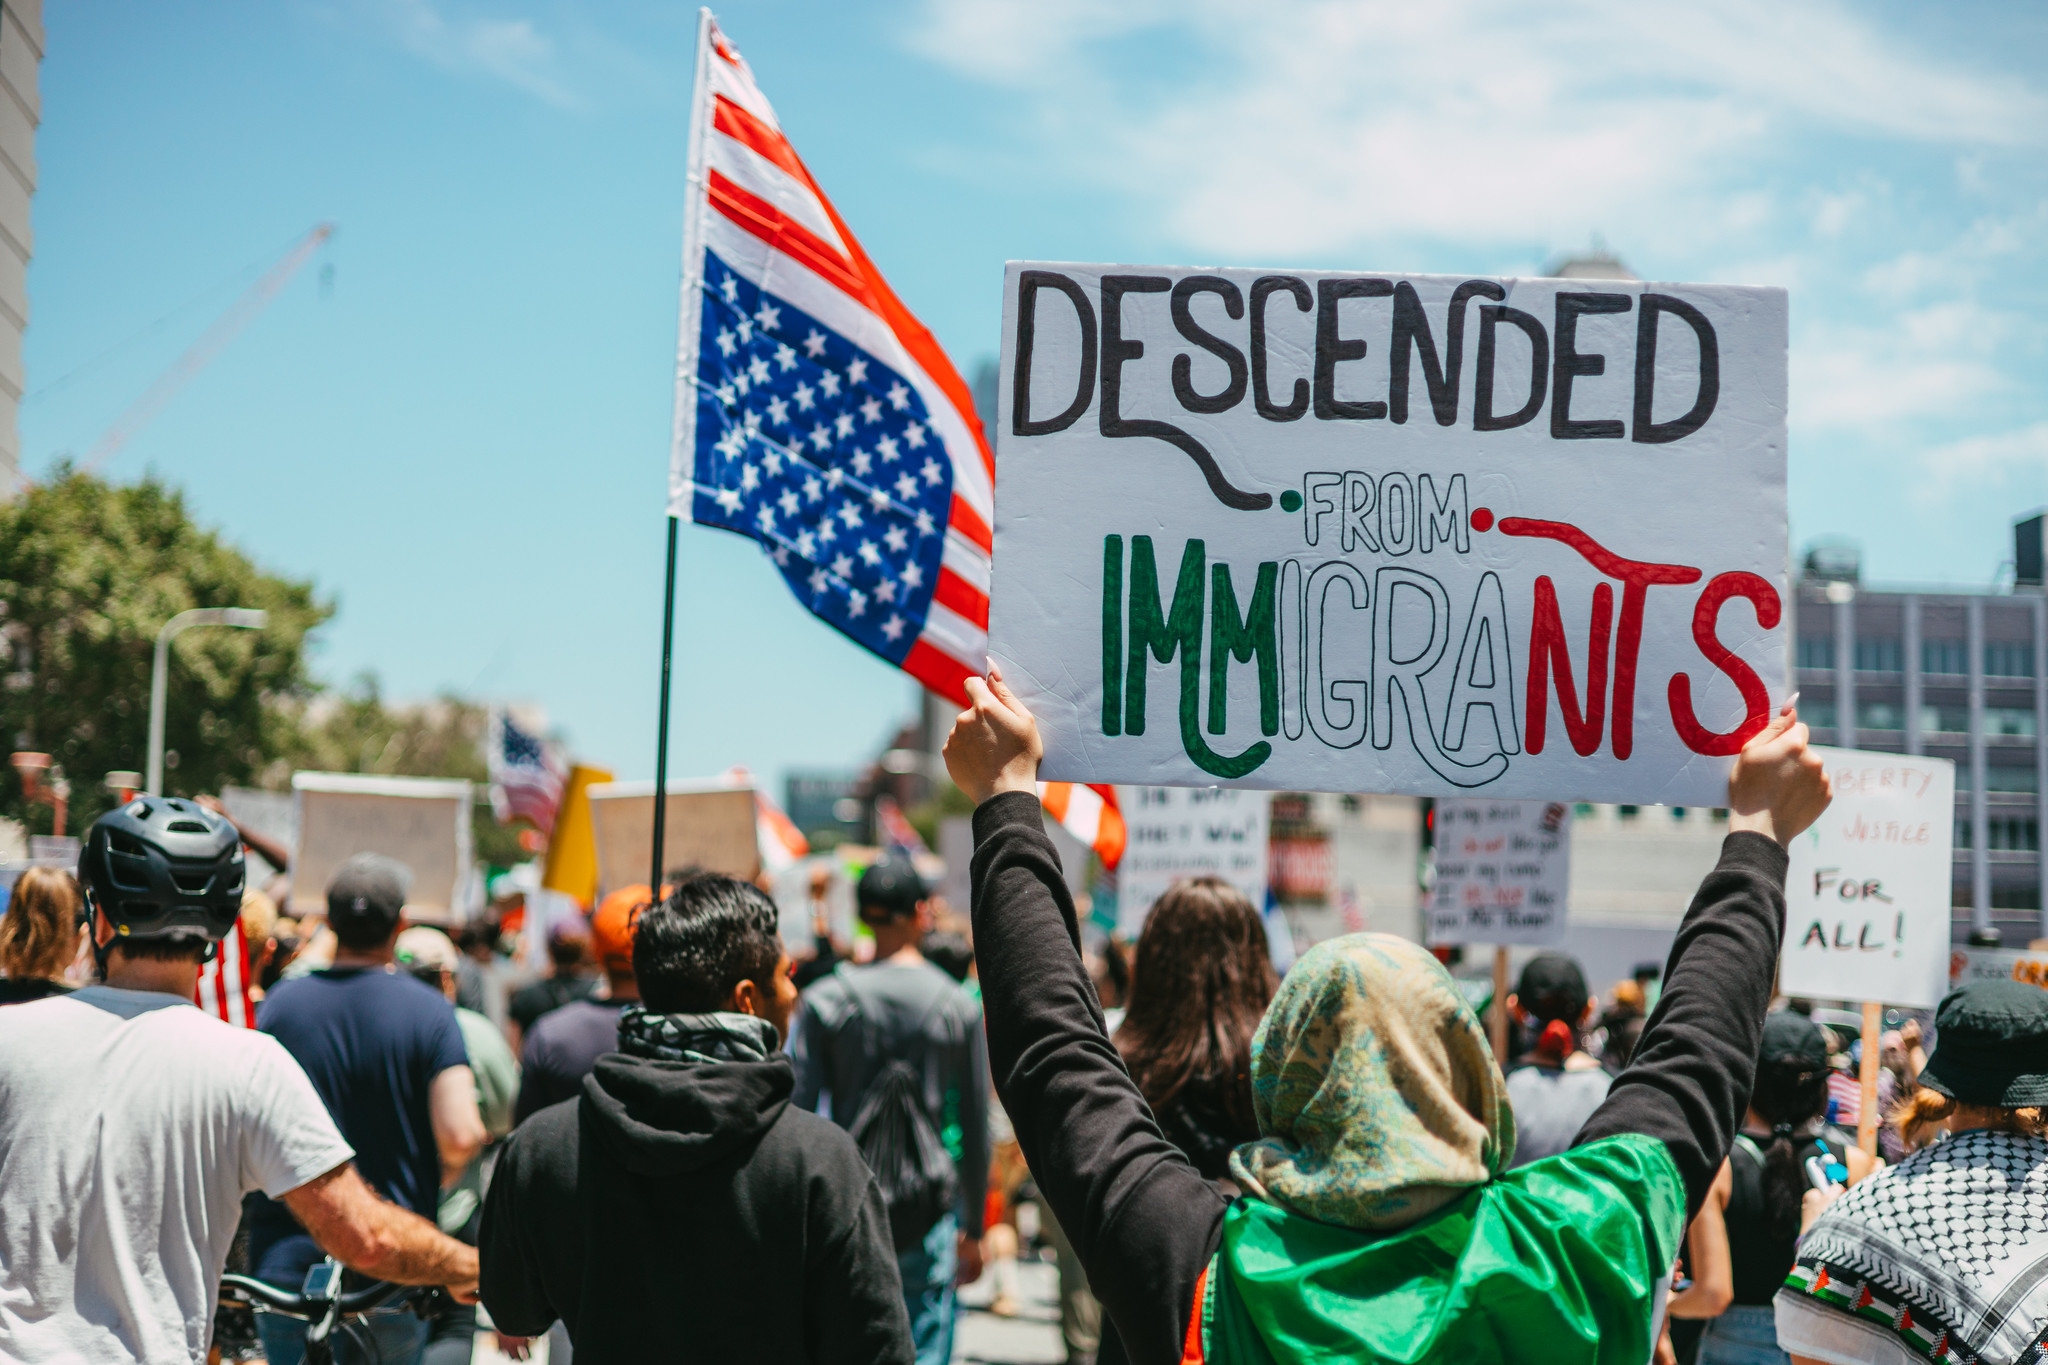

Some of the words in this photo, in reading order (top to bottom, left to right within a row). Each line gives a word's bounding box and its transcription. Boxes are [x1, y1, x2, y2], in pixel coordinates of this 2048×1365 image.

[1012, 270, 1720, 443] DESCENDED
[1303, 471, 1470, 556] FROM
[1102, 517, 1782, 788] IMMIGRANTS
[1833, 767, 1934, 799] BERTY
[1842, 812, 1931, 845] JUSTICE
[1813, 865, 1894, 904] FOR
[1799, 910, 1904, 958] ALL!
